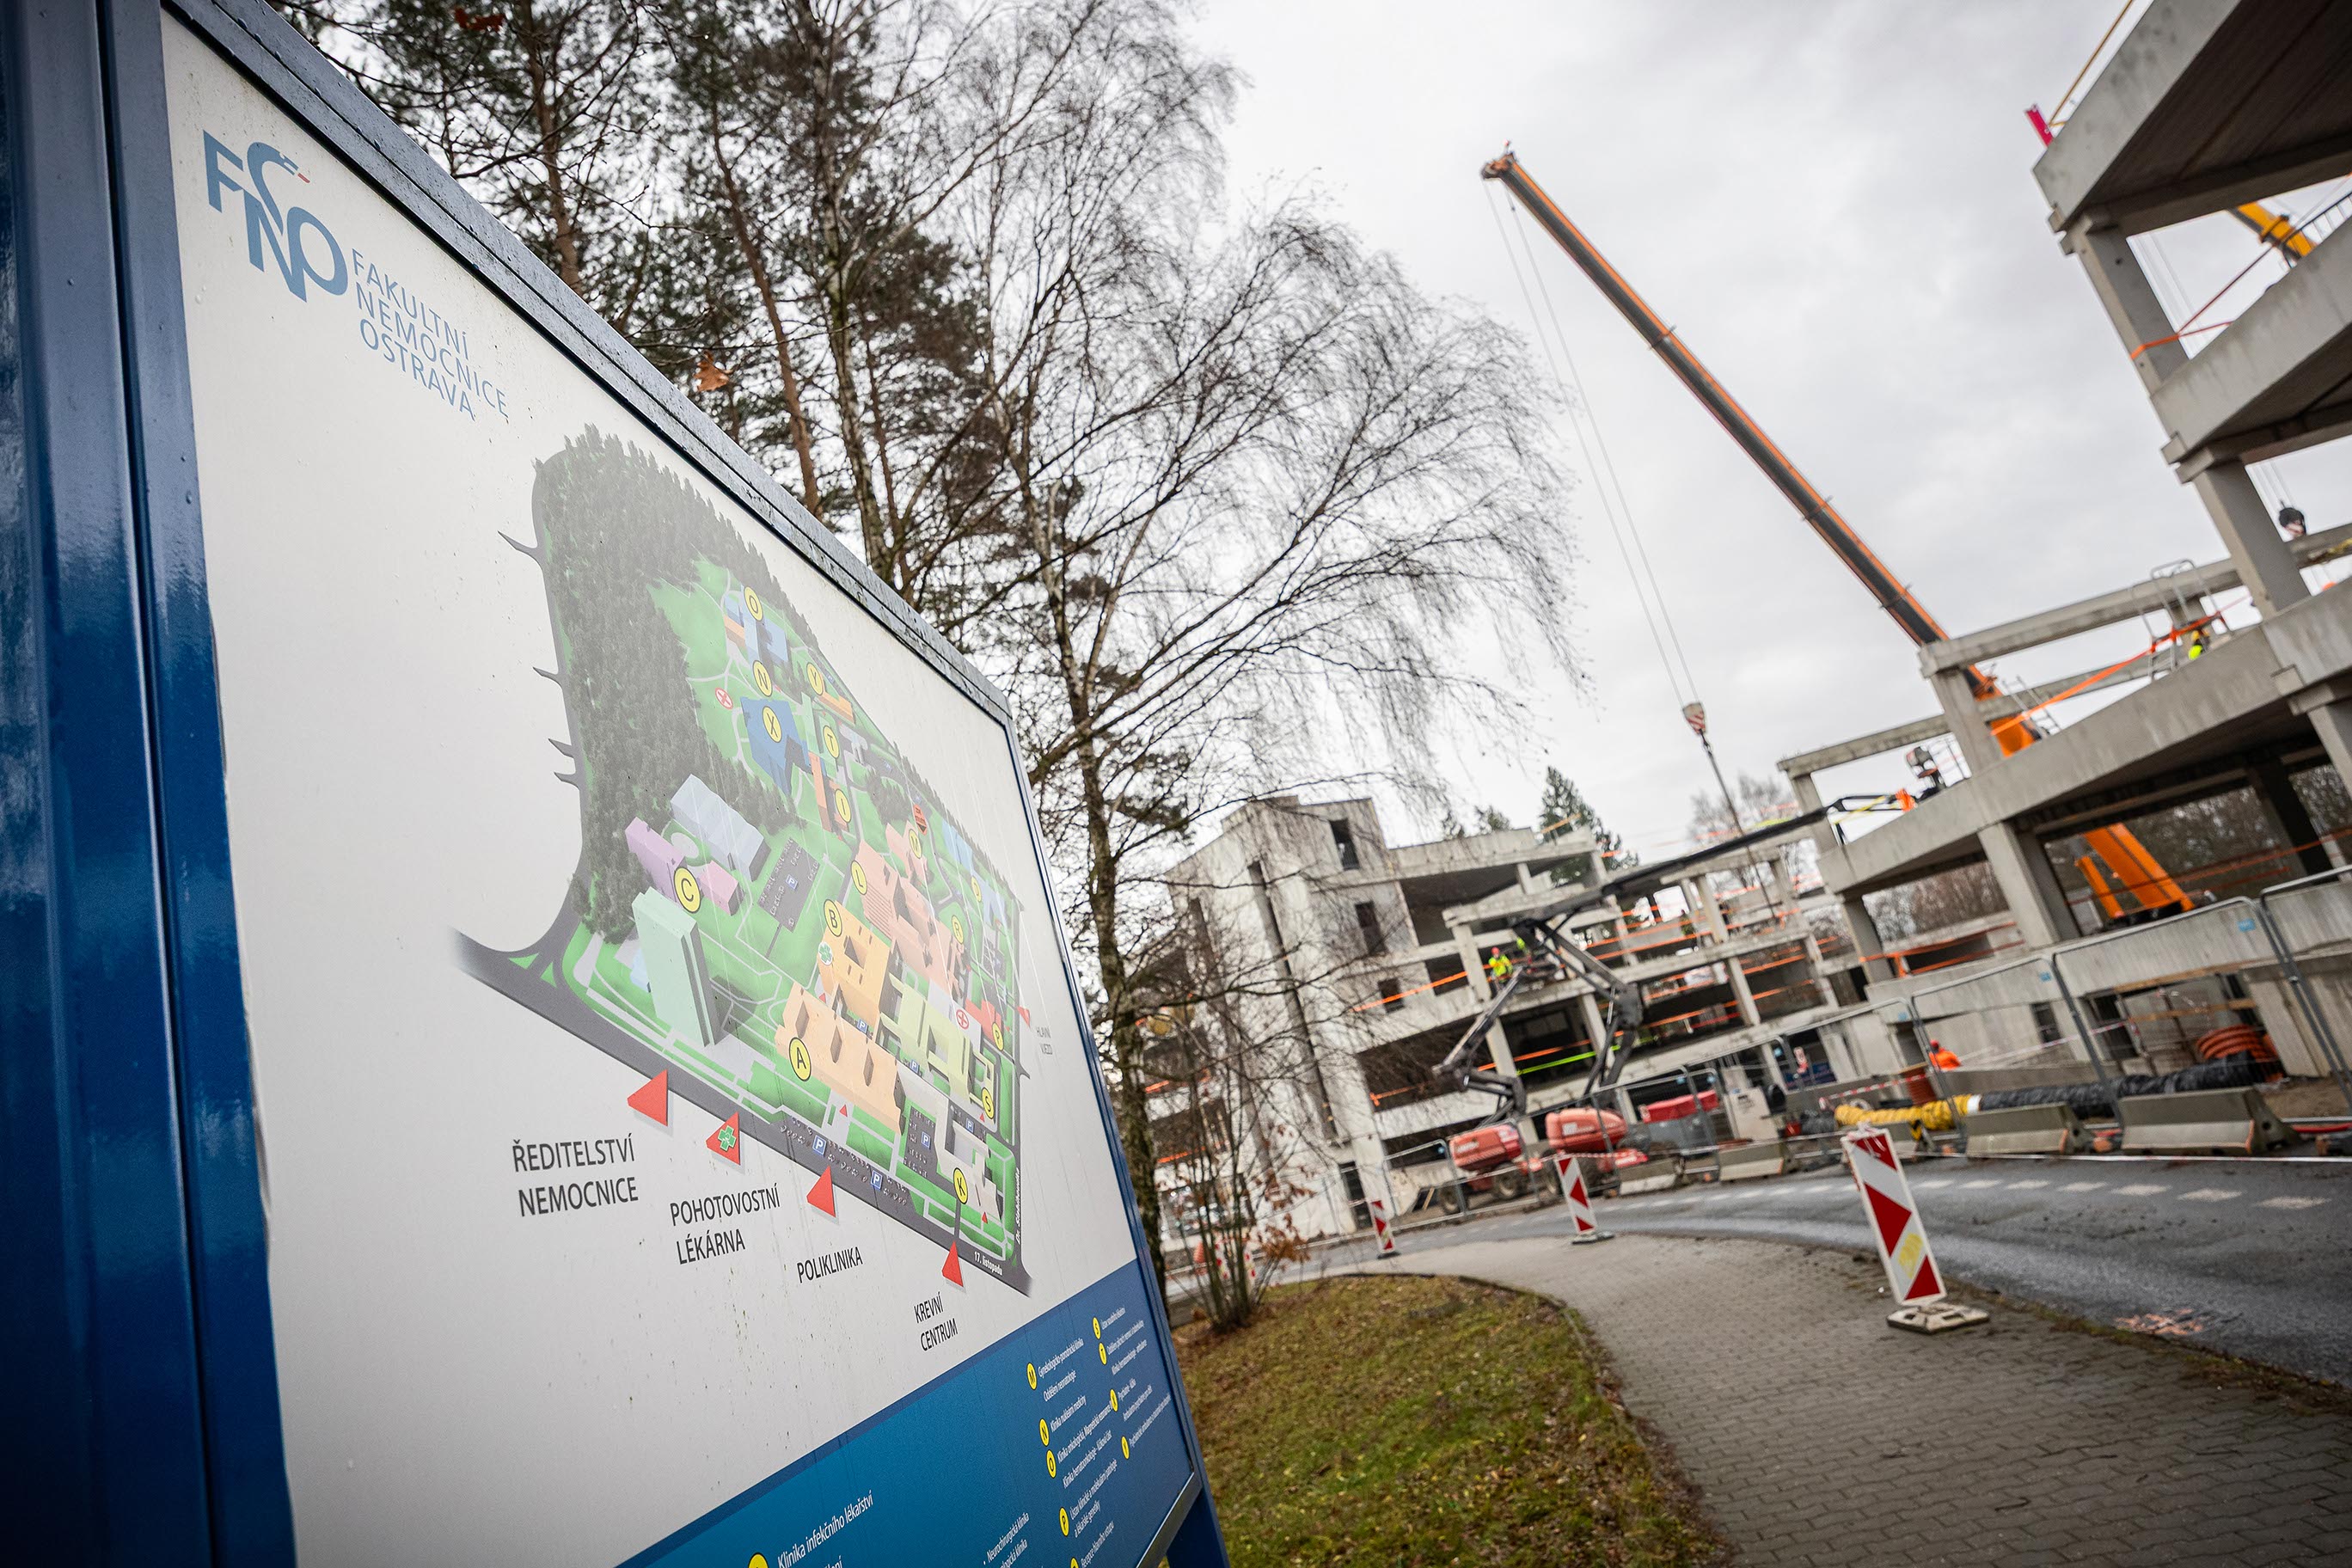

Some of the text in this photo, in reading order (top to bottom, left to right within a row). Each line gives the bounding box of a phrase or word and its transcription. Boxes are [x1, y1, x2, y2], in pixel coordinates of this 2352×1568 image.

[352, 248, 469, 360] FAKULTNÍ
[356, 282, 509, 419] NEMOCNICE
[359, 319, 476, 421] OSTRAVA
[749, 595, 759, 615] O
[757, 668, 769, 691] N
[767, 712, 779, 739] X
[681, 877, 695, 903] C
[829, 909, 838, 929] B
[796, 1046, 807, 1069] A
[512, 1133, 635, 1173] ŘEDITELSTVÍ
[518, 1176, 639, 1217] NEMOCNICE
[670, 1183, 781, 1227] POHOTOVOSTNÍ
[957, 1177, 966, 1197] K
[676, 1228, 745, 1265] LÉKÁRNA
[796, 1246, 863, 1283] POLIKLINIKA
[914, 1291, 944, 1324] KREVNÍ
[920, 1318, 959, 1351] CENTRUM
[777, 1489, 873, 1568] Klinika infekčního lékařství
[987, 1521, 1020, 1563] Neurochirurgická
